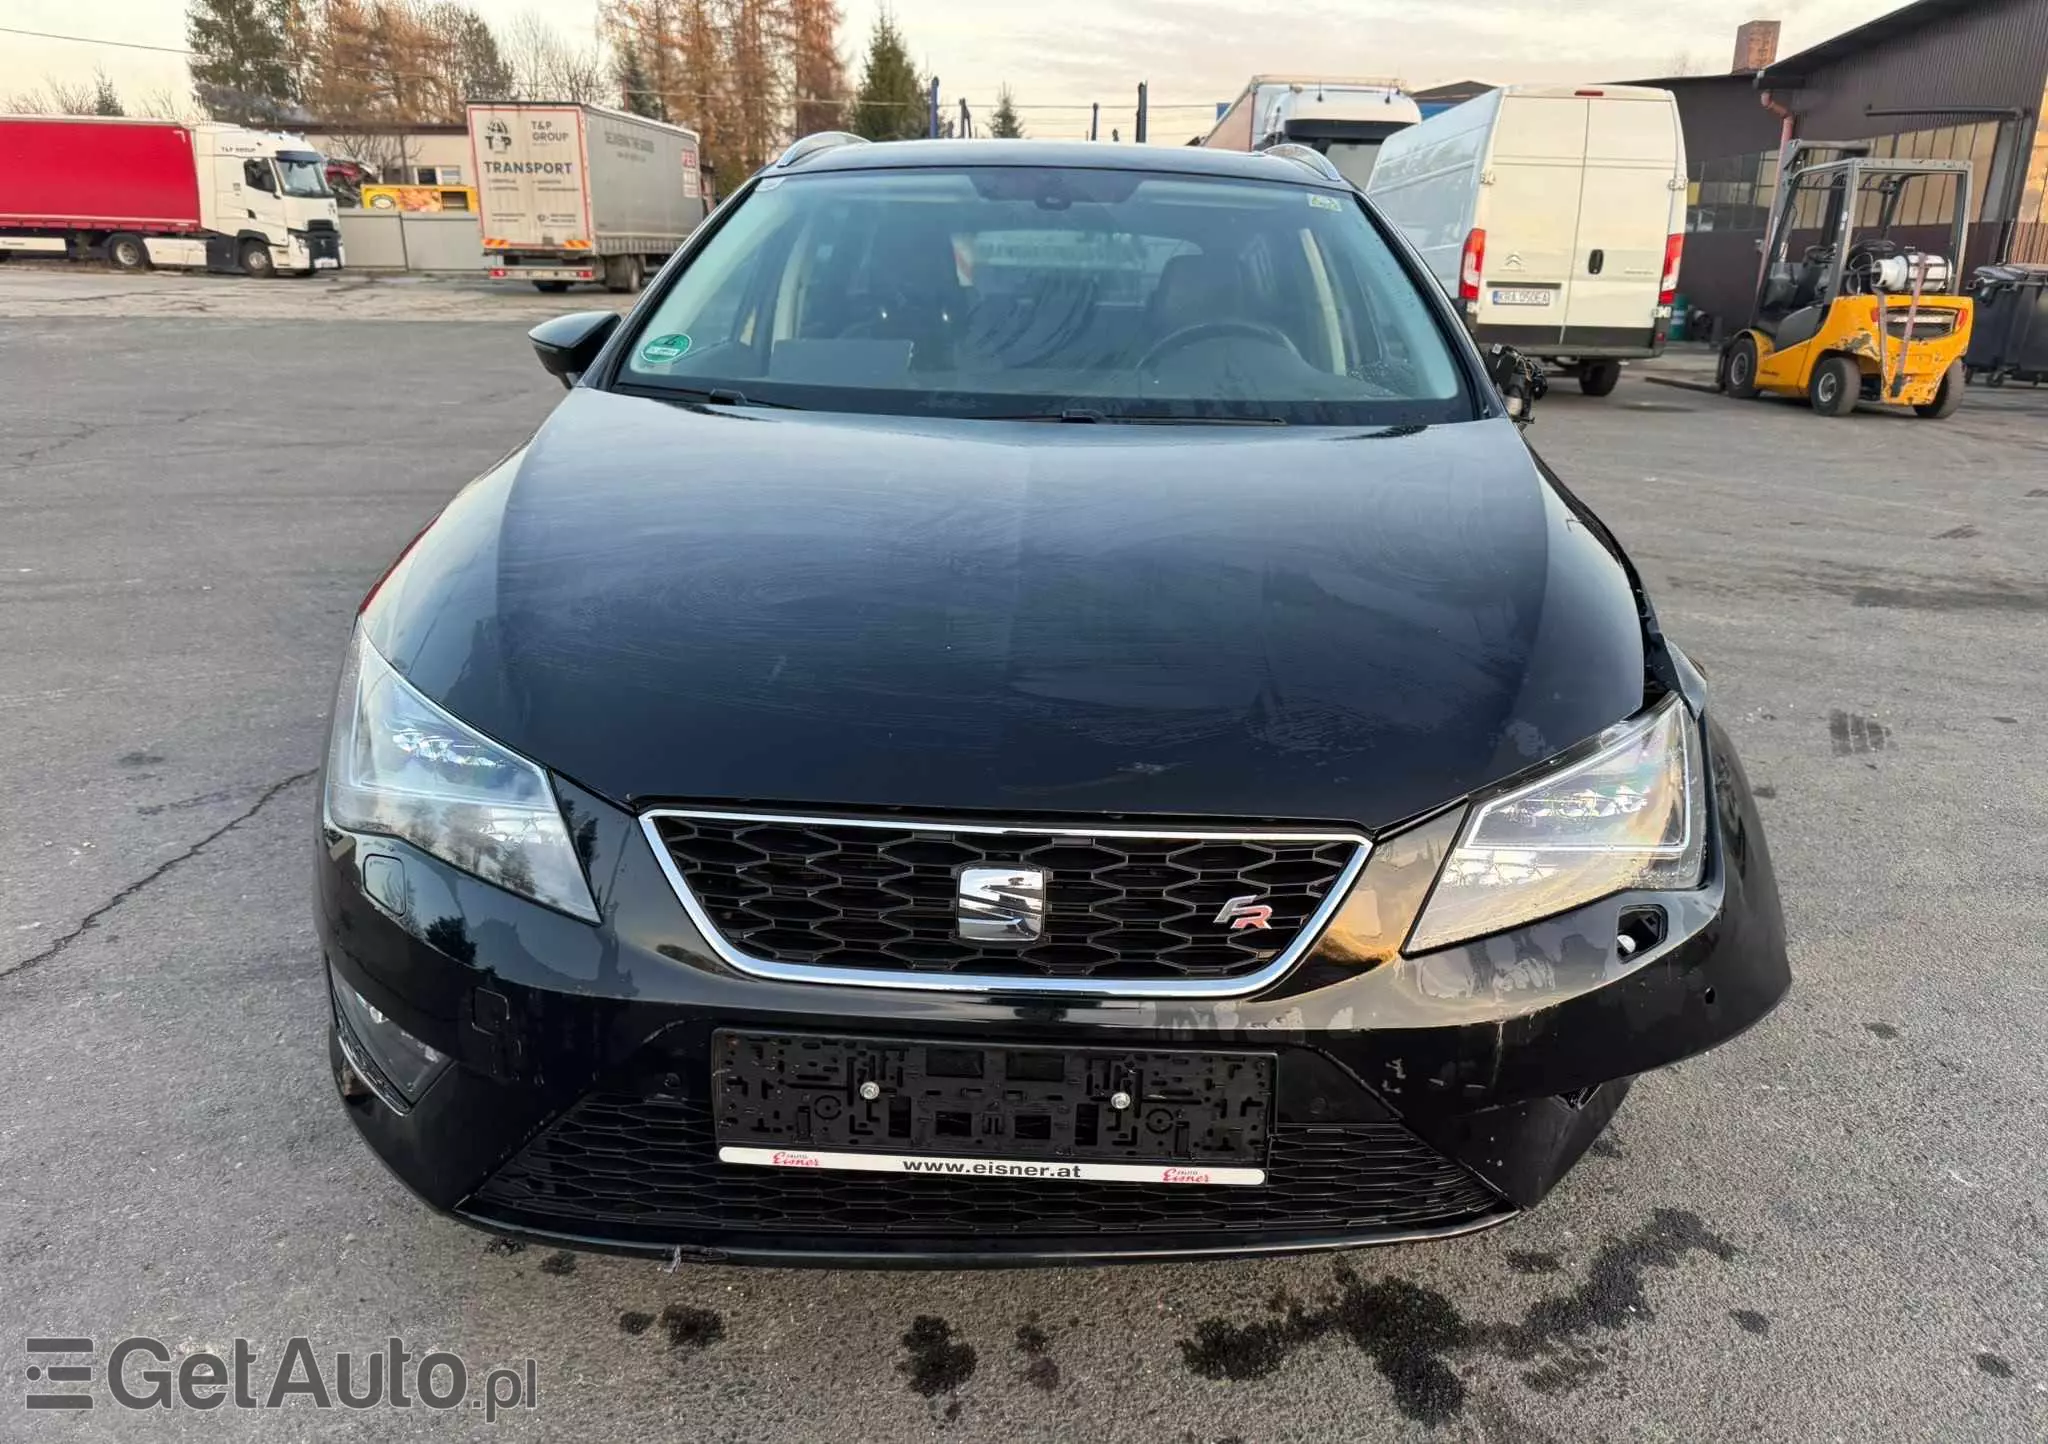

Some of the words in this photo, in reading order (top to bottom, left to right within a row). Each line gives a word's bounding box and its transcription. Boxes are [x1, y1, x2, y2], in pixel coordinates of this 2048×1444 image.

[531, 121, 552, 130] T&P
[532, 132, 569, 142] GROUP
[484, 161, 573, 175] TRANSPORT
[1213, 894, 1273, 930] FR
[903, 1160, 1081, 1178] www.eisner.at
